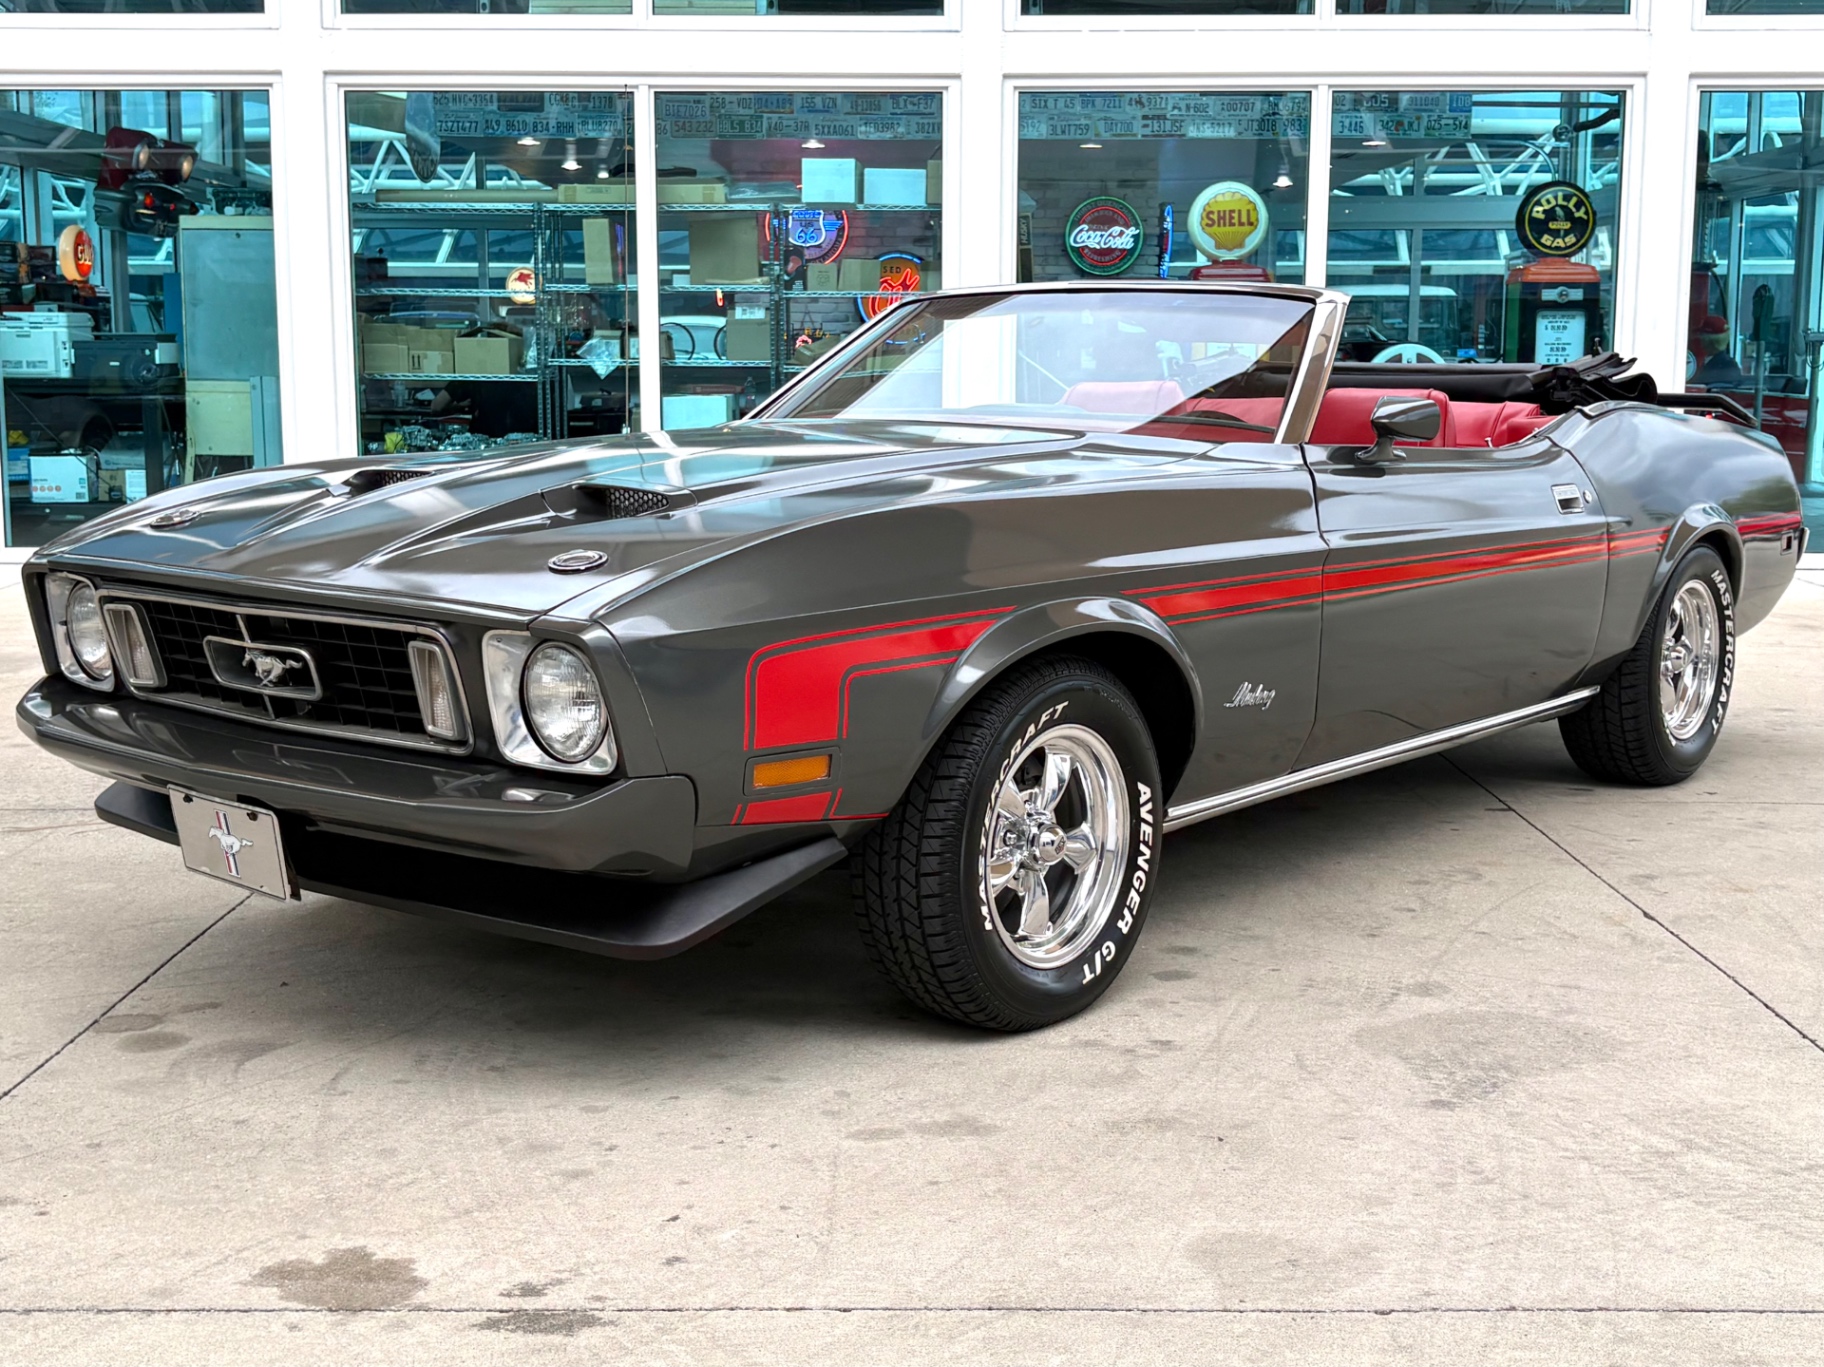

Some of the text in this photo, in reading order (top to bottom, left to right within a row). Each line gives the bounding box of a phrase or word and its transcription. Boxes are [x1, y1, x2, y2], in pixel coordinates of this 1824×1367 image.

[1204, 208, 1255, 228] SHELL
[1531, 191, 1588, 221] POLLY
[795, 227, 818, 244] 66
[1540, 233, 1577, 248] GAS
[1711, 569, 1736, 735] MASTERCRAFT
[1081, 781, 1154, 985] AVENGER G/T
